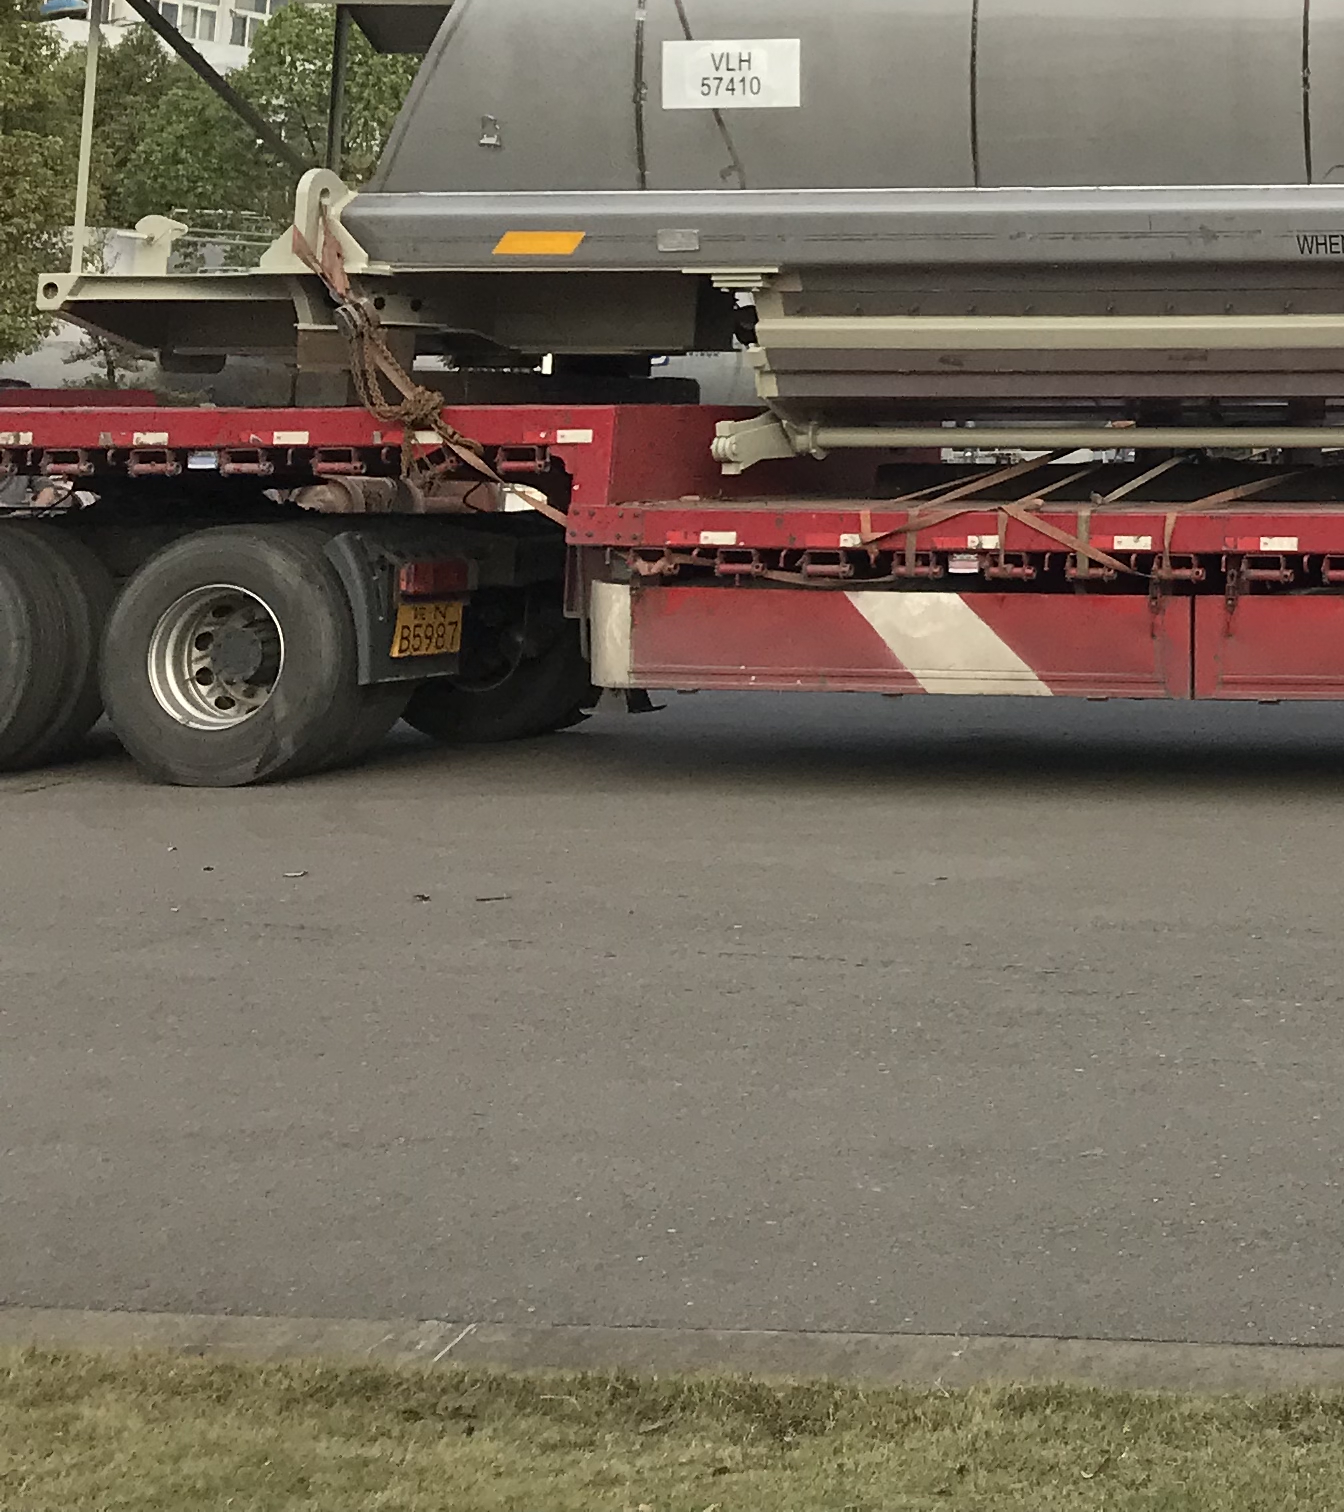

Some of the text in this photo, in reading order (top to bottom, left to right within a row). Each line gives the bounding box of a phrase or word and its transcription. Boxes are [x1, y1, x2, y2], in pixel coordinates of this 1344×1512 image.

[710, 51, 752, 72] VLH
[700, 76, 761, 96] 57410
[398, 621, 458, 653] B5987
